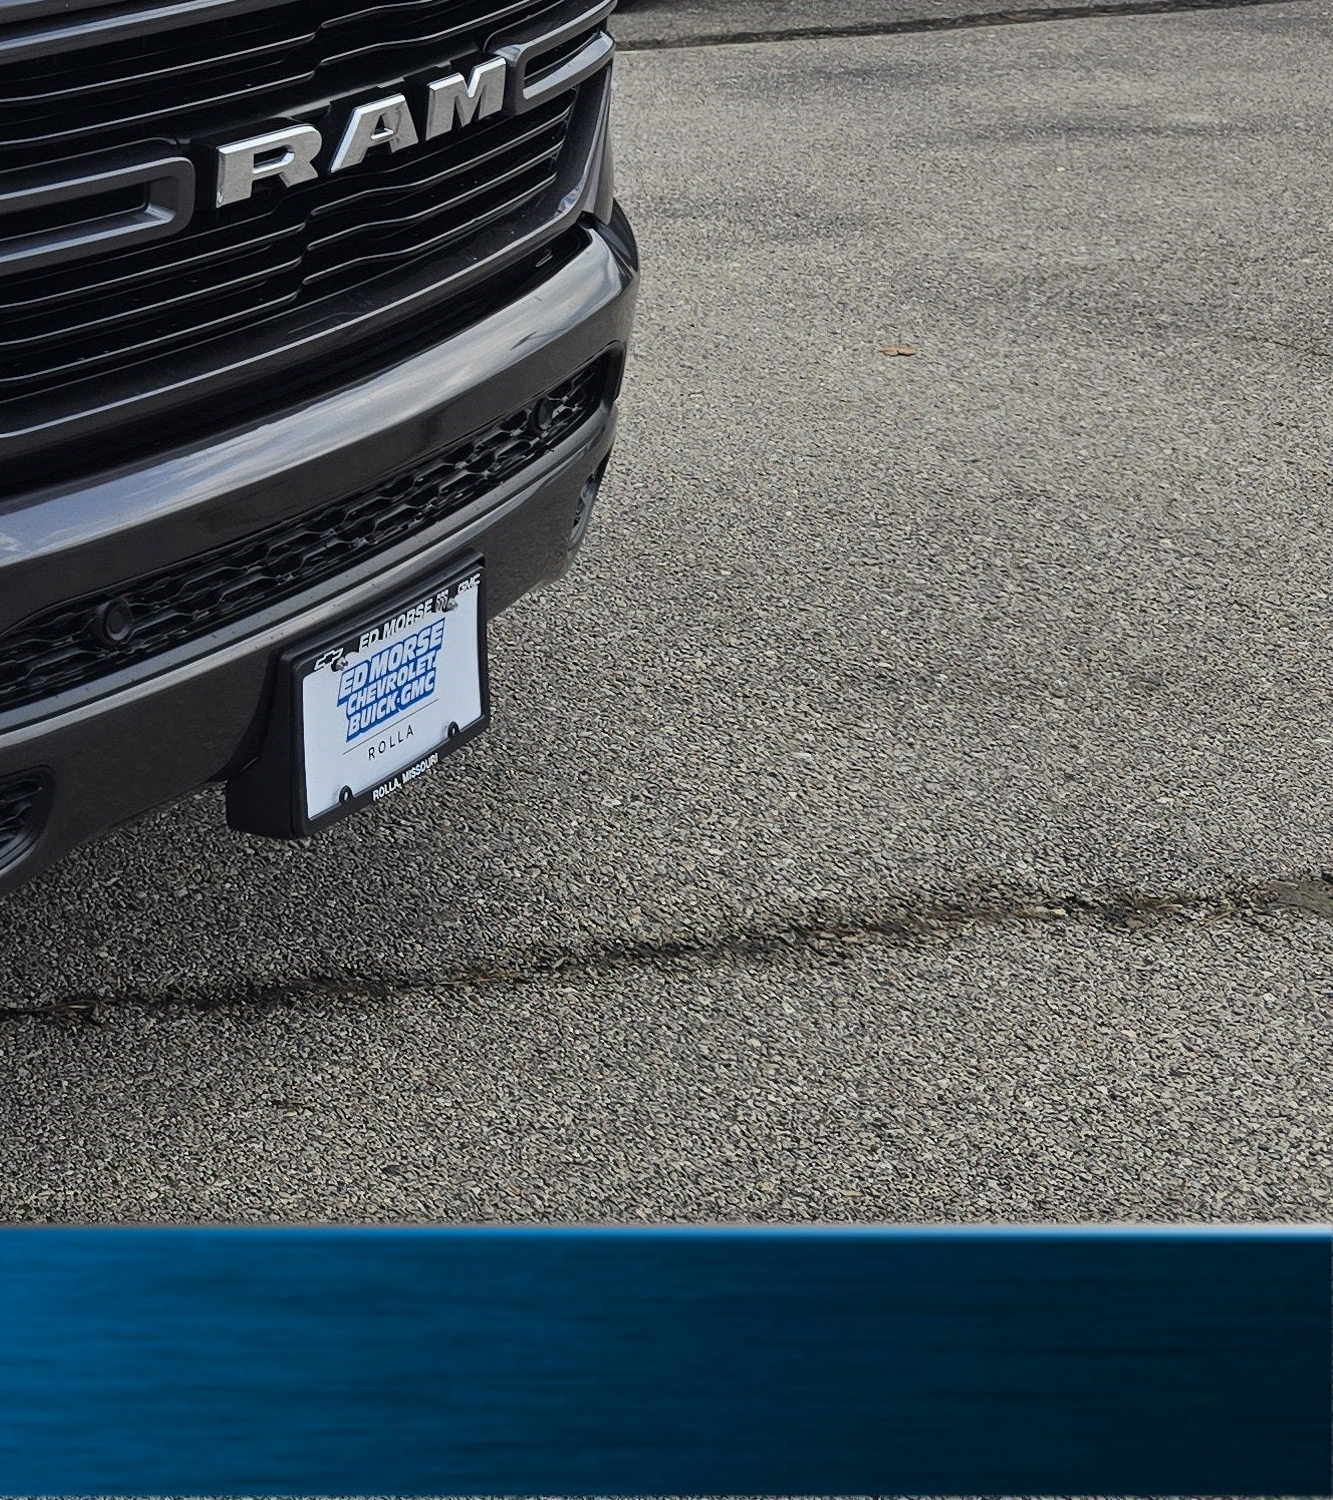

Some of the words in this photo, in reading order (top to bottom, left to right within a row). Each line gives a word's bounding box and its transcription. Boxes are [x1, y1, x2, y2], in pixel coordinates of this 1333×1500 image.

[215, 57, 507, 209] RAM
[358, 628, 380, 652] ED
[382, 598, 434, 640] MORSE
[457, 573, 481, 595] GMC
[338, 661, 369, 703] ED
[368, 619, 445, 684] MORSE
[347, 650, 436, 717] CHEVROLET
[368, 724, 414, 761] ROLLA
[402, 752, 439, 784] MISSOURI
